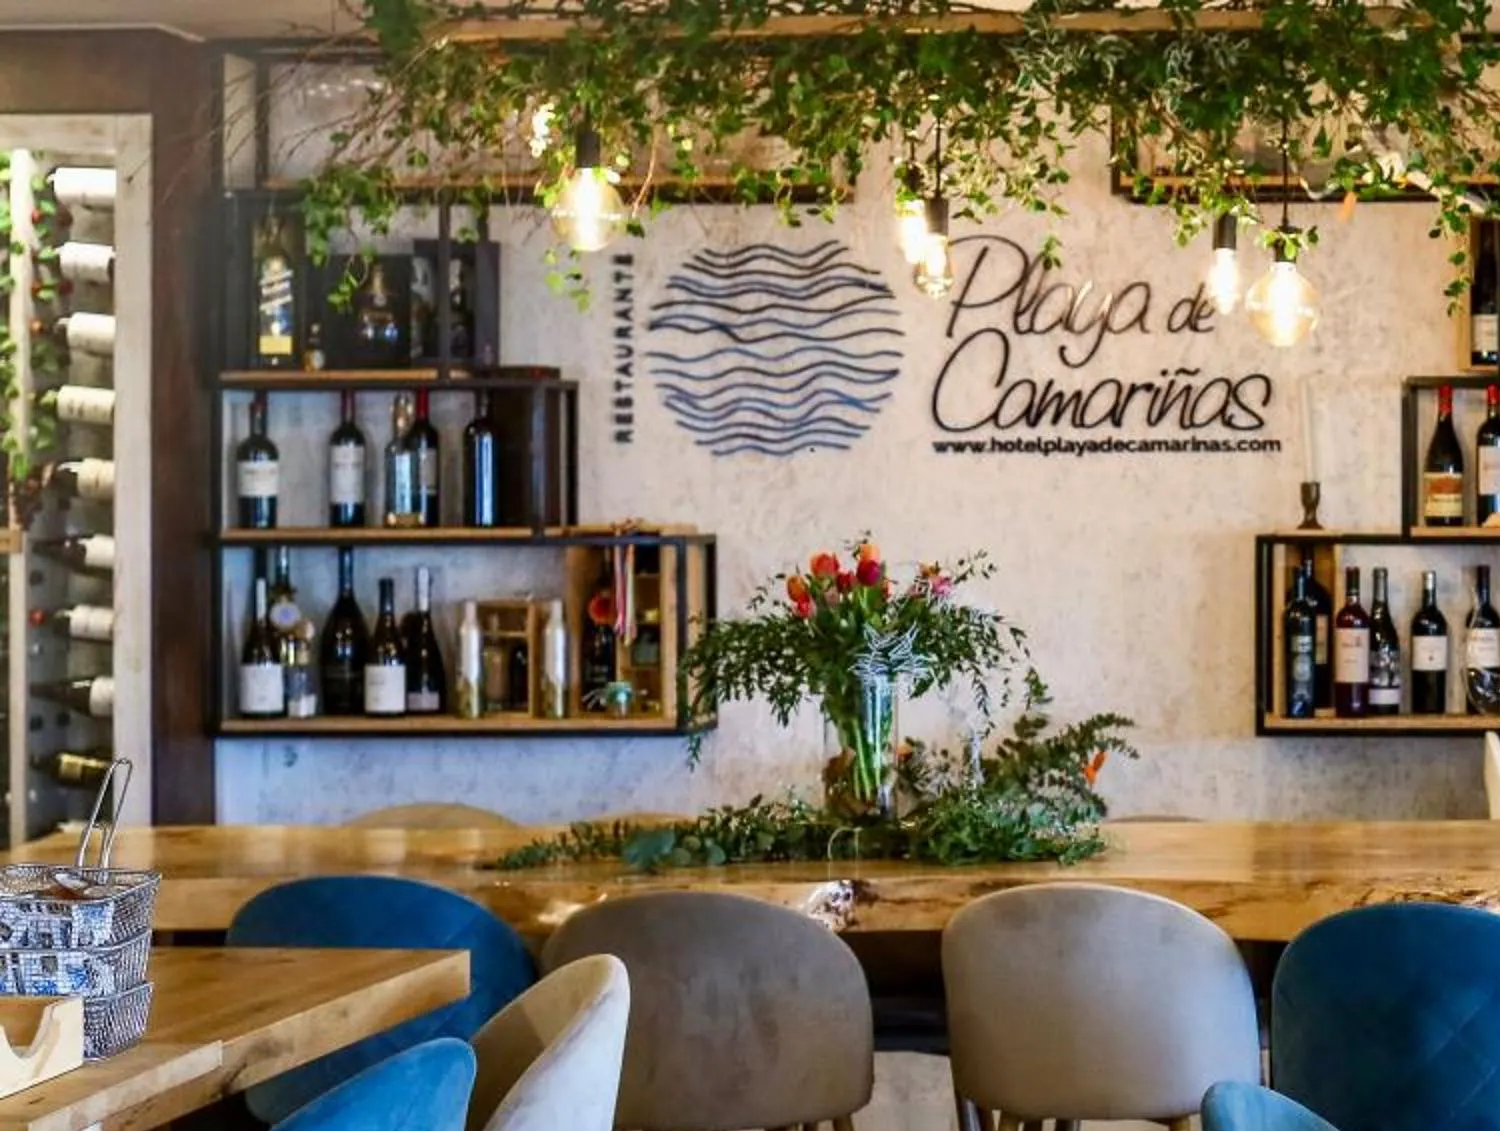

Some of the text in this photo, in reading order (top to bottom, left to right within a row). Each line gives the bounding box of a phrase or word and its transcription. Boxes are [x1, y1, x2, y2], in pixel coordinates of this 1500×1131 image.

[612, 253, 634, 444] RESTAURANTE
[946, 235, 1216, 368] Playa de
[930, 328, 1274, 434] Camariñas
[931, 436, 1283, 457] www.hotelplayadecamarinas.com
